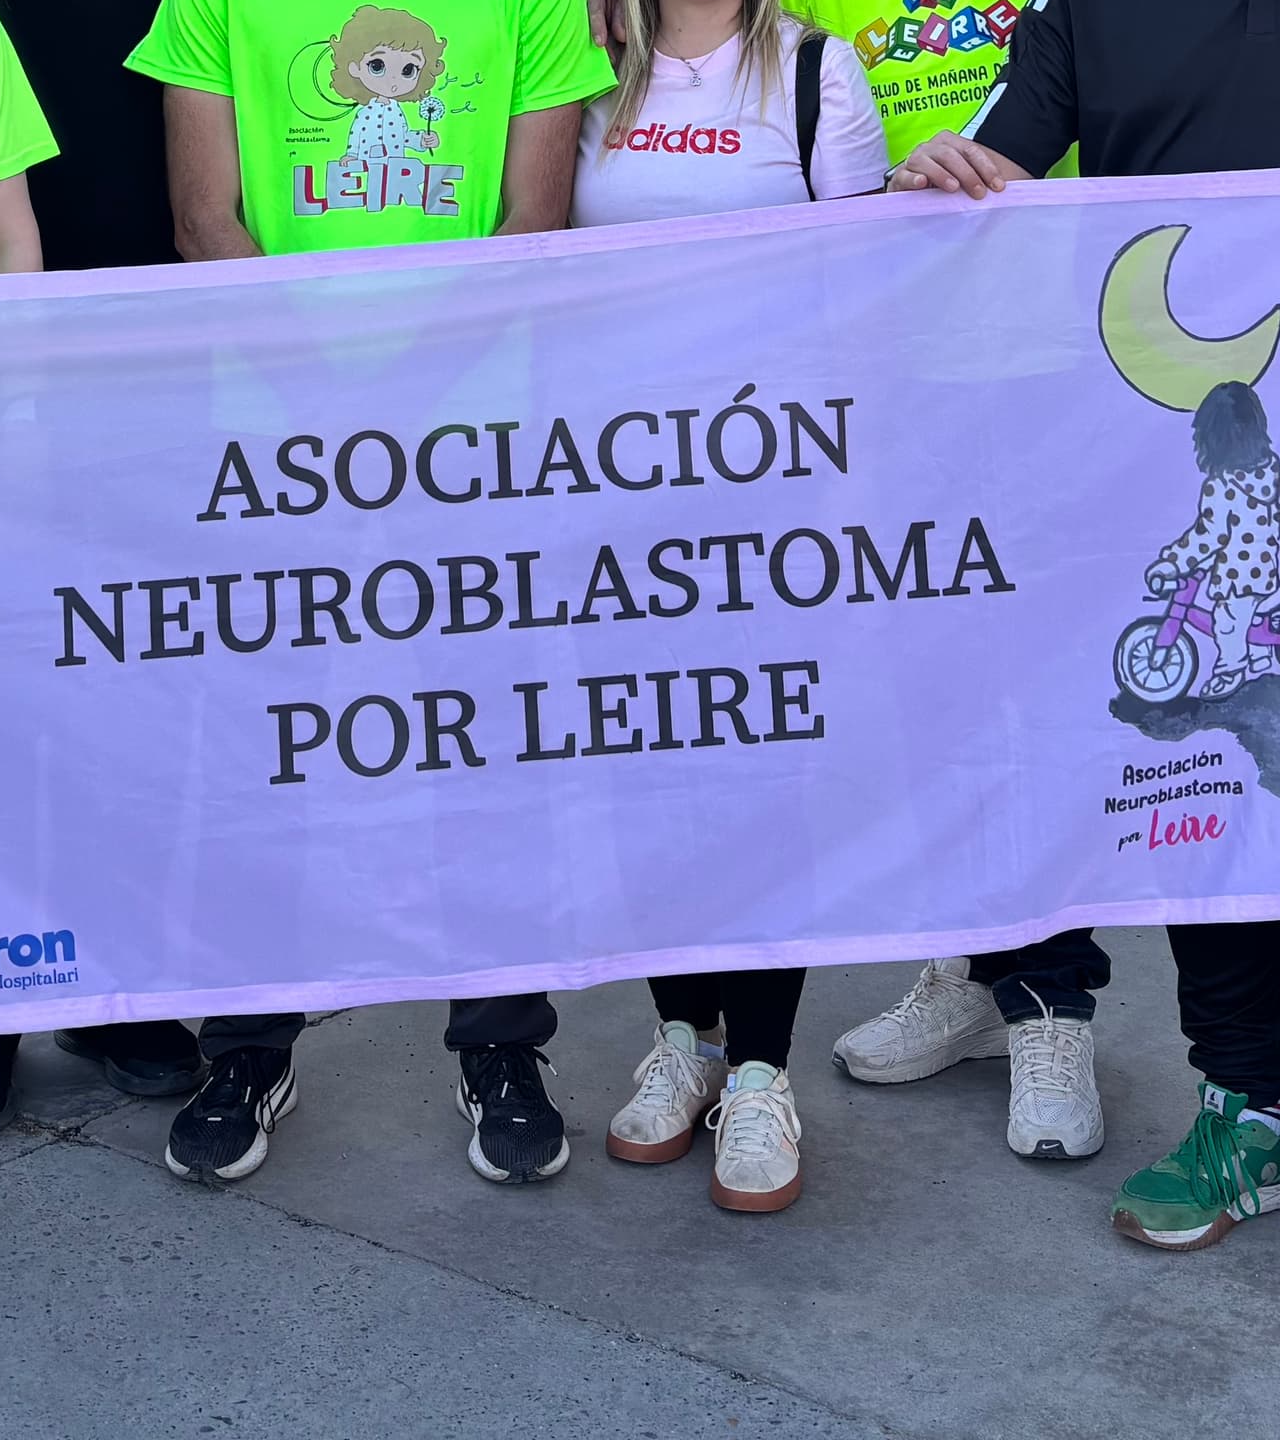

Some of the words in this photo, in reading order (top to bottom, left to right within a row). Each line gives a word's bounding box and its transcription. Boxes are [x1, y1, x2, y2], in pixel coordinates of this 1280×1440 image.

[871, 82, 900, 100] ALUD
[905, 78, 921, 93] DE
[927, 65, 988, 90] MAÑANA
[293, 145, 465, 217] LEIRE
[196, 382, 855, 524] ASOCIACIÓN
[53, 516, 1016, 668] NEUROBLASTOMA
[266, 689, 487, 786] POR
[513, 660, 827, 764] LEIRE
[1104, 779, 1244, 814] Neuroblastoma
[1122, 751, 1223, 786] Asociación
[1117, 830, 1143, 853] por
[1148, 808, 1228, 851] Leire
